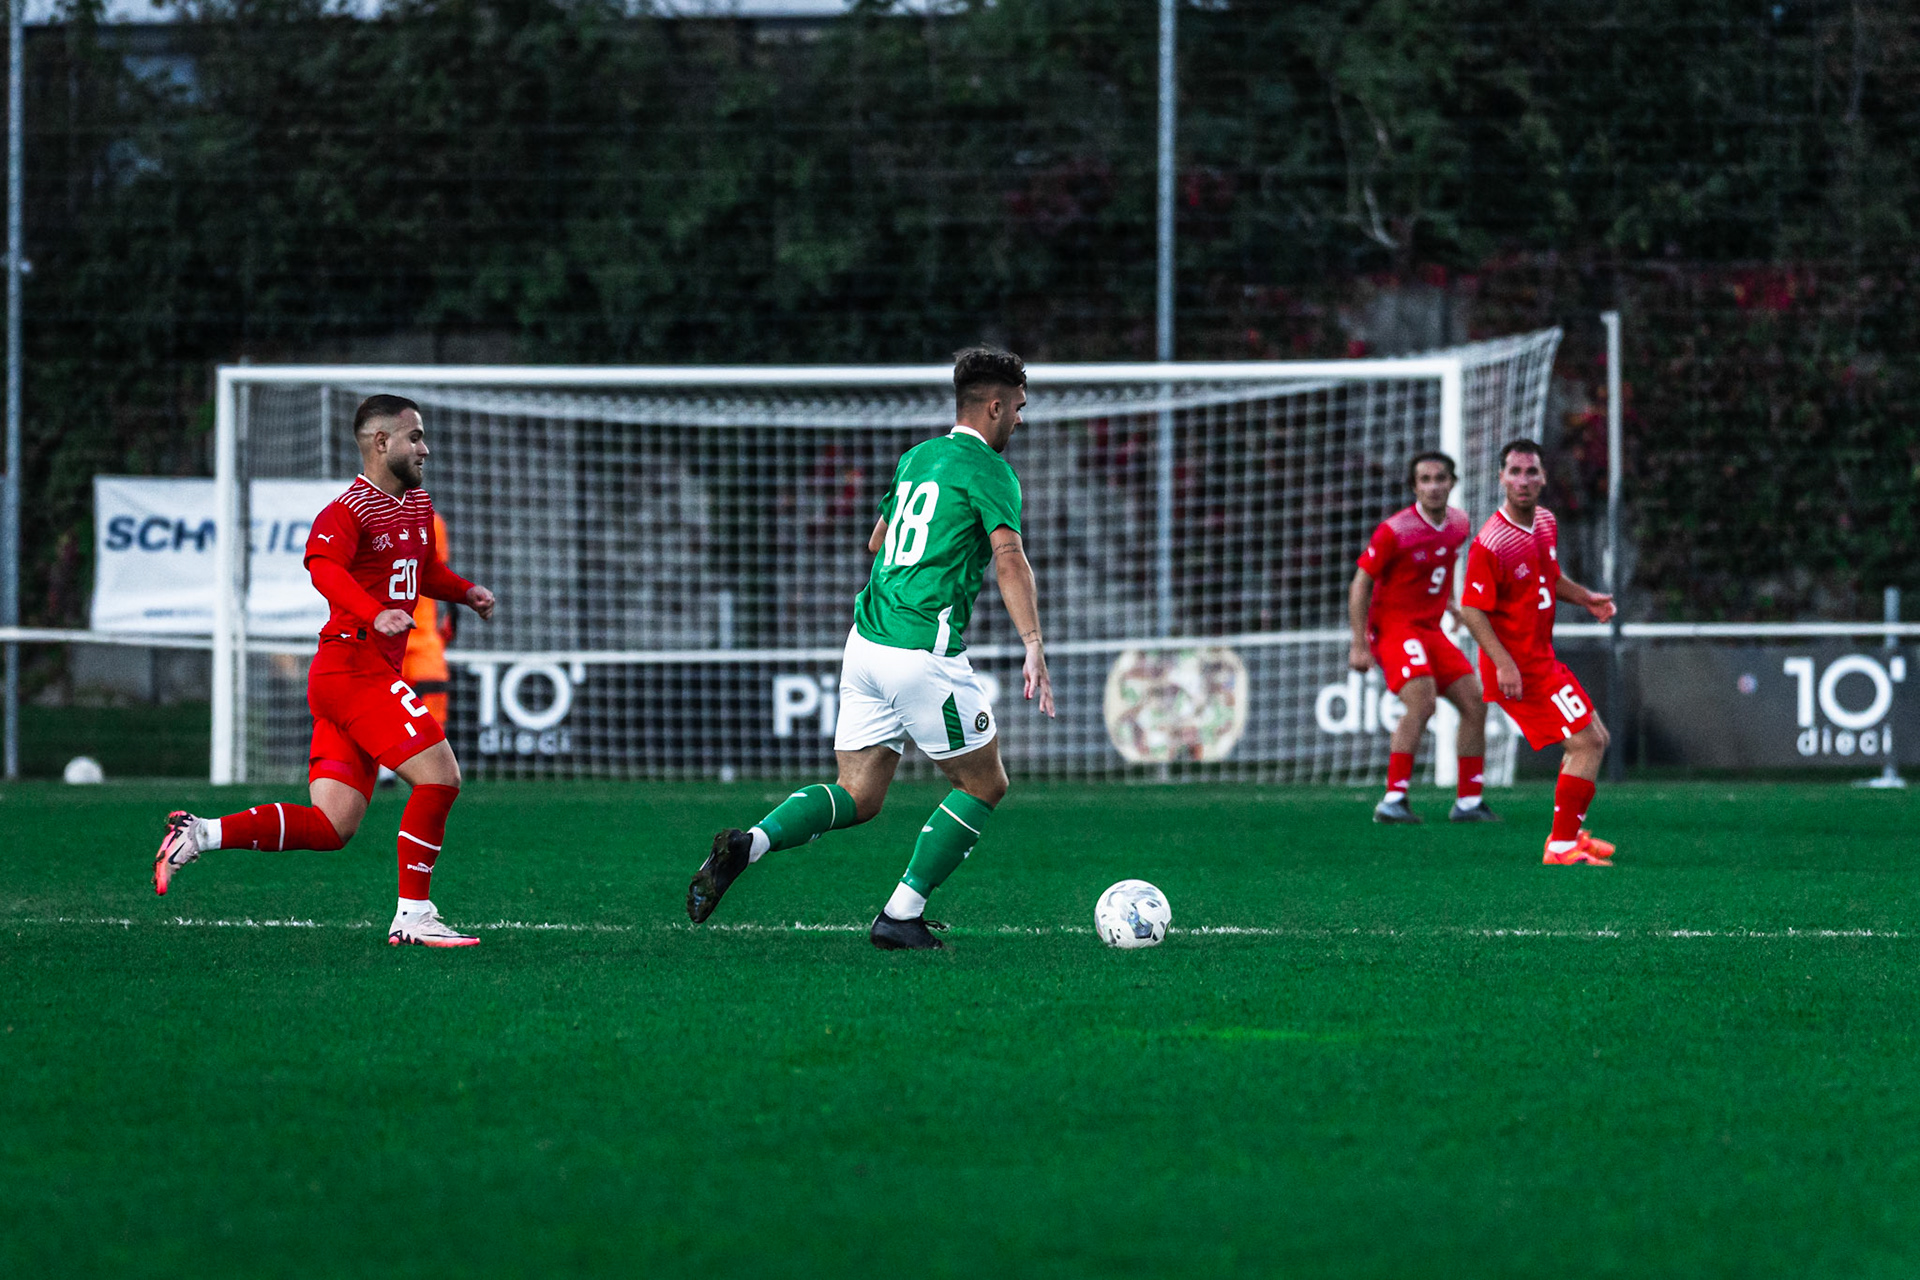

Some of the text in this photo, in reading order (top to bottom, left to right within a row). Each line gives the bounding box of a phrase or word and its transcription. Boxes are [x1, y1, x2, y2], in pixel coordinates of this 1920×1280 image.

[883, 481, 940, 567] 18
[388, 558, 418, 600] 20
[1428, 566, 1446, 594] 9
[1403, 638, 1427, 666] 9
[1551, 684, 1587, 723] 16
[1796, 724, 1892, 756] dieci
